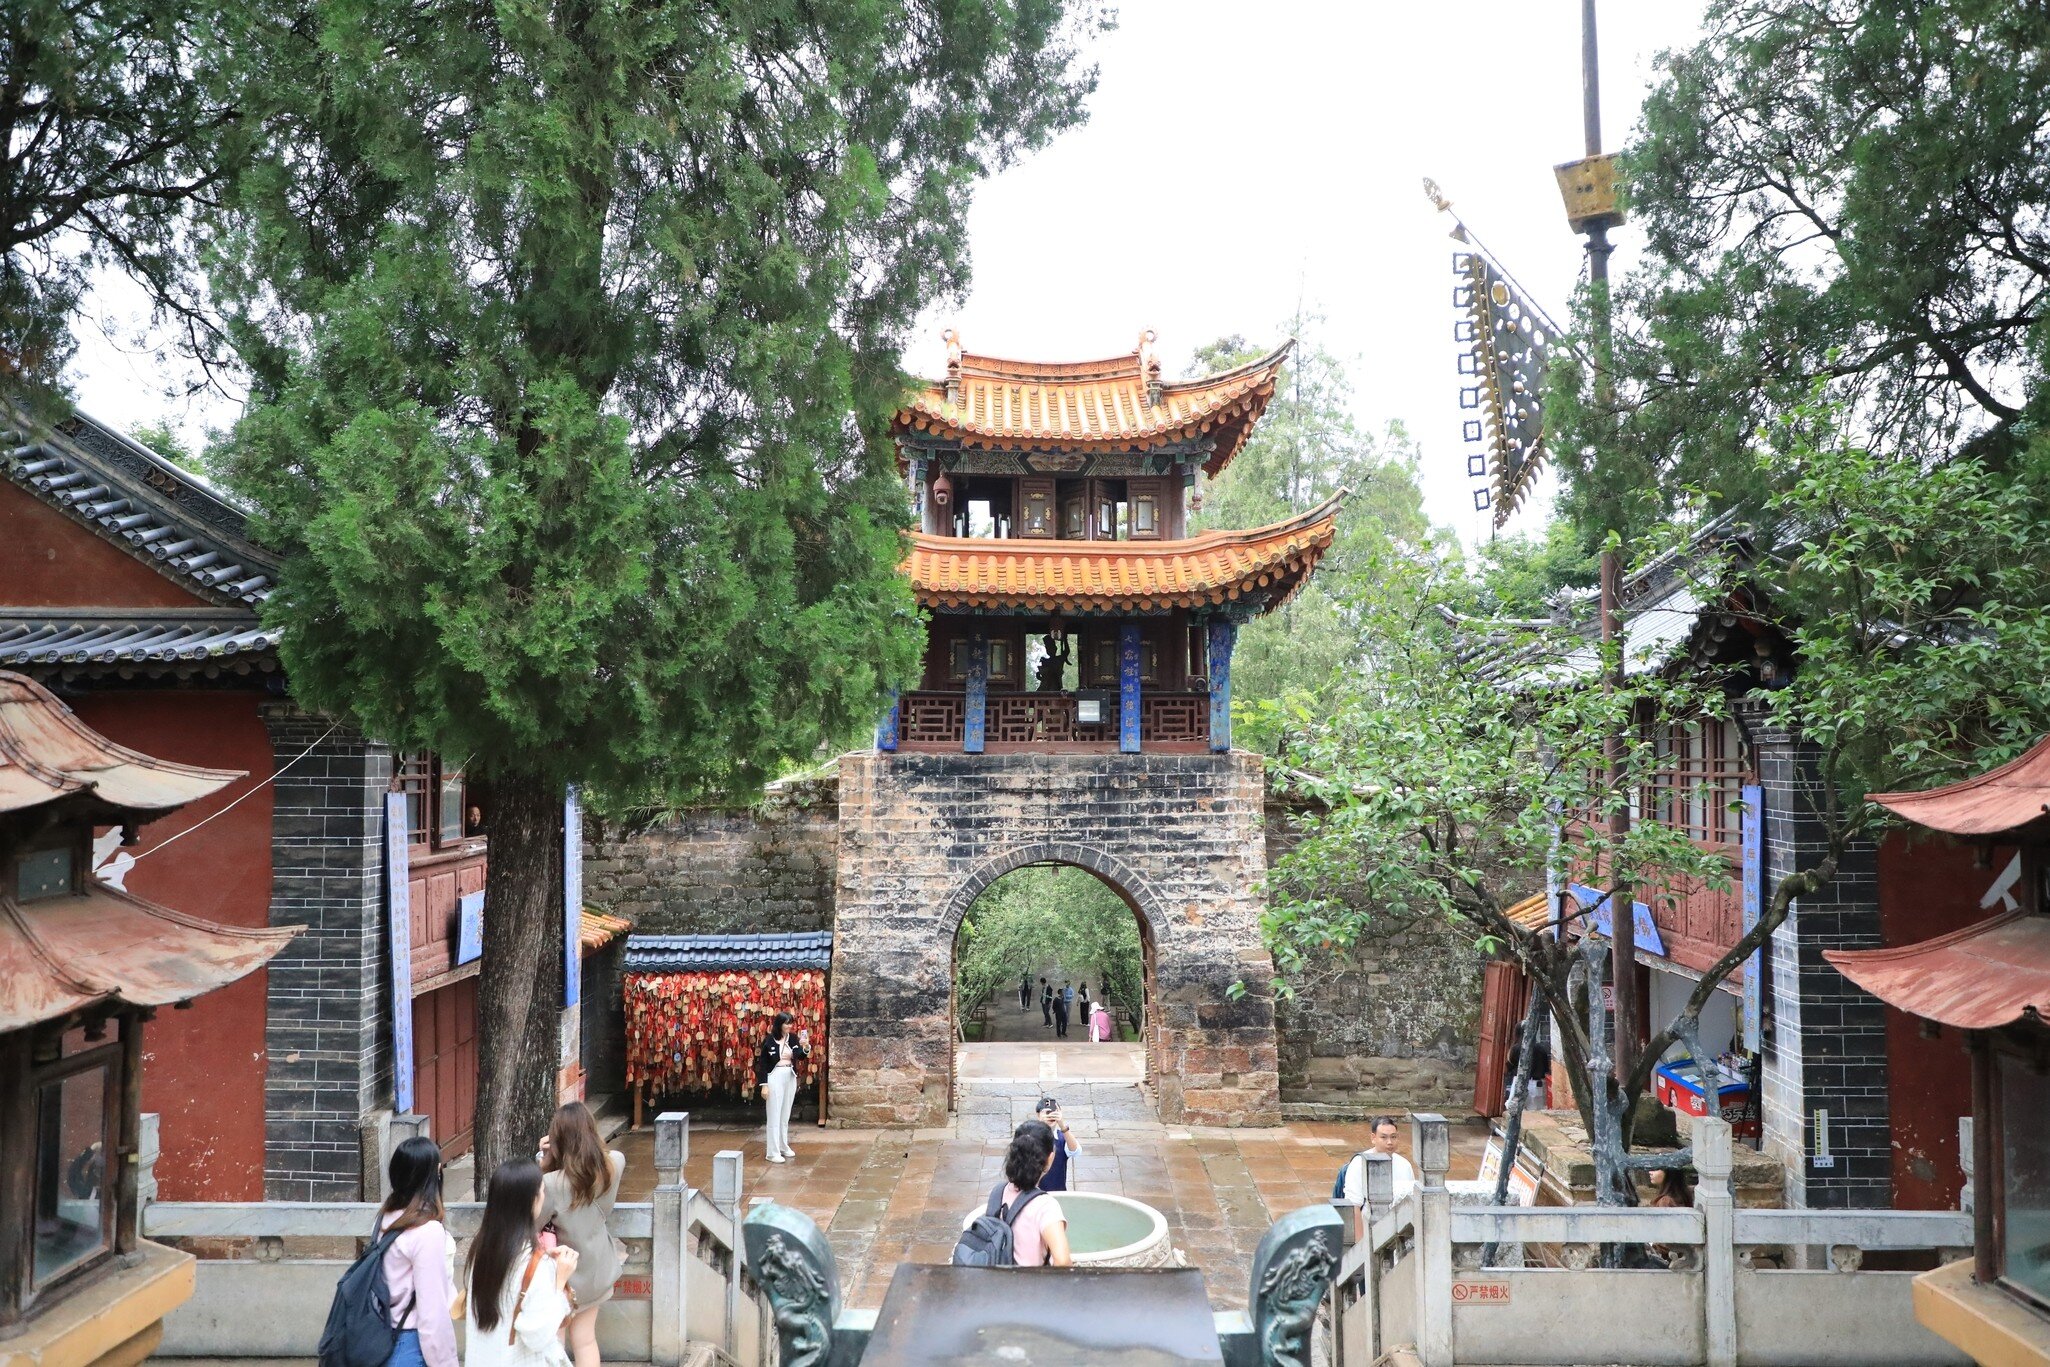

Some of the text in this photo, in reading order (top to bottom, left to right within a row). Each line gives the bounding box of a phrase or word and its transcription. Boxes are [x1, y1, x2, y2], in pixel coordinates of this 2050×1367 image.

[613, 1280, 651, 1294] 严禁烟火
[1470, 1285, 1508, 1299] 严禁烟火
